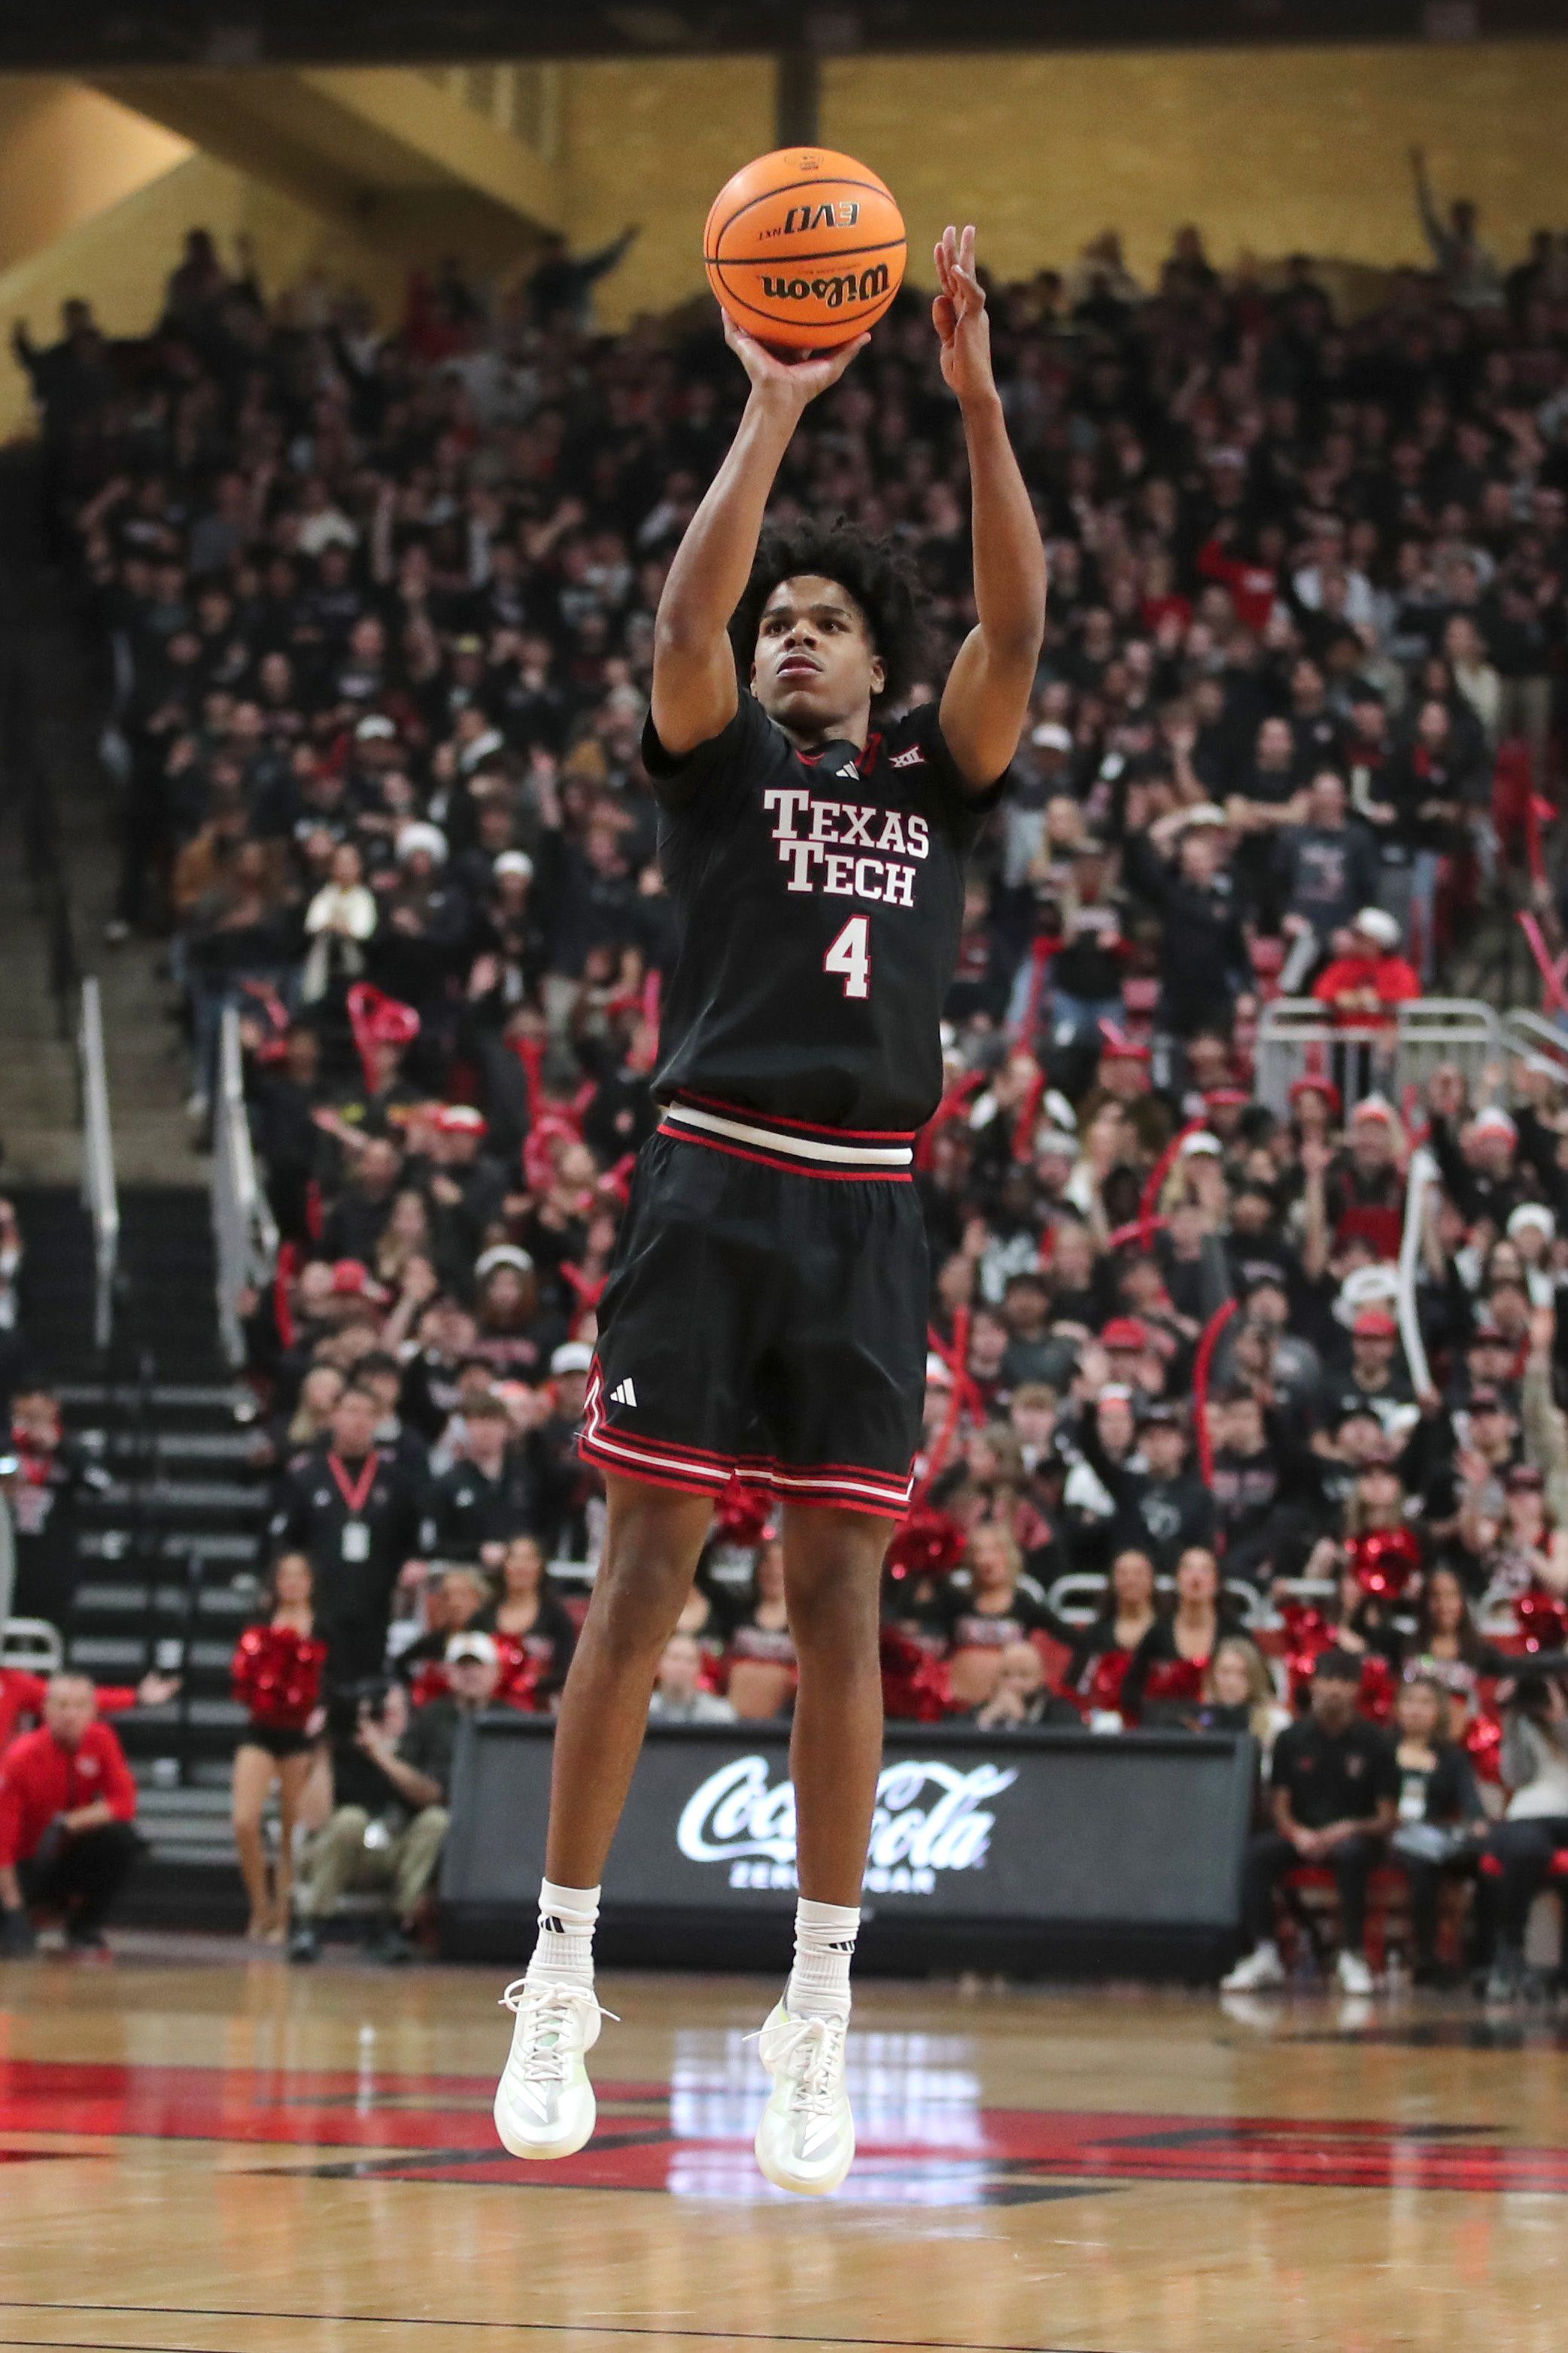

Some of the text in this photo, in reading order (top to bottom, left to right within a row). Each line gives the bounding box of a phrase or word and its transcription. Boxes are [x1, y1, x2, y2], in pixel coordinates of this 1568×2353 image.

[784, 201, 859, 234] EVO
[761, 263, 889, 309] Wilson
[763, 789, 930, 859] TEXAS
[778, 839, 916, 907] TECH
[824, 915, 870, 999] 4
